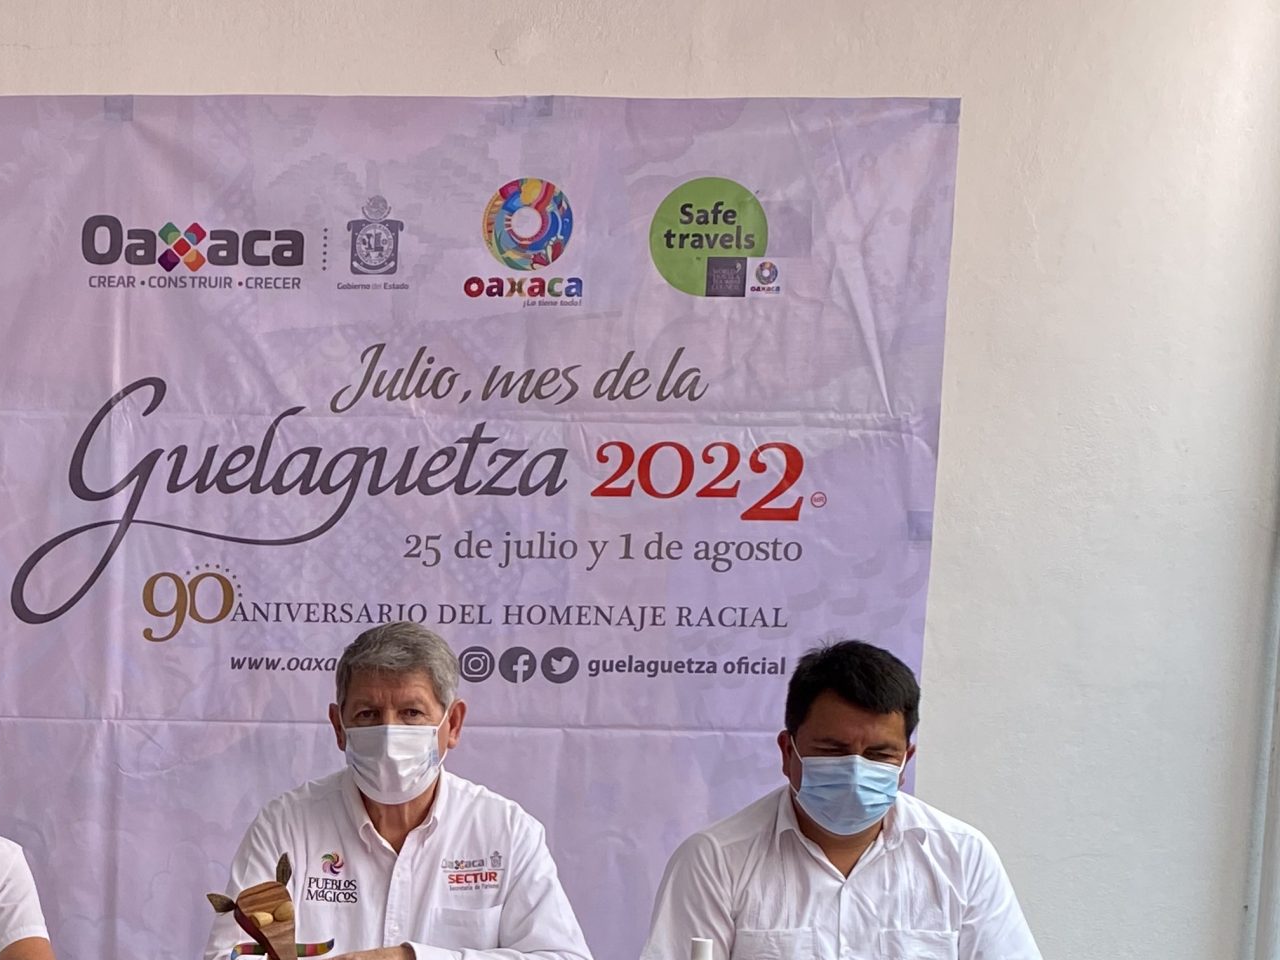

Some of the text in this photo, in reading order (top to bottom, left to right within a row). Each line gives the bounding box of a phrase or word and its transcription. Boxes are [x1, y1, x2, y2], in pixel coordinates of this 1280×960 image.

[679, 200, 738, 227] Safe
[81, 214, 305, 273] Oaxaca
[663, 225, 756, 251] travels
[88, 275, 302, 290] CREAR CONSTRUIR CRECER
[336, 282, 371, 291] Gobierno
[383, 282, 410, 290] Estado
[463, 276, 584, 298] oaxaca
[330, 342, 710, 414] Julio, mes de la
[10, 375, 805, 627] Guelaguetza 2022
[402, 530, 803, 573] 25 de julio y 1 de agosto
[141, 571, 789, 643] 90 ANIVERSARIO DEL HOMENAJE RACIAL
[587, 654, 787, 679] guelaguetza oficial
[308, 876, 358, 891] PUEBLOS
[448, 871, 498, 884] SECTUR
